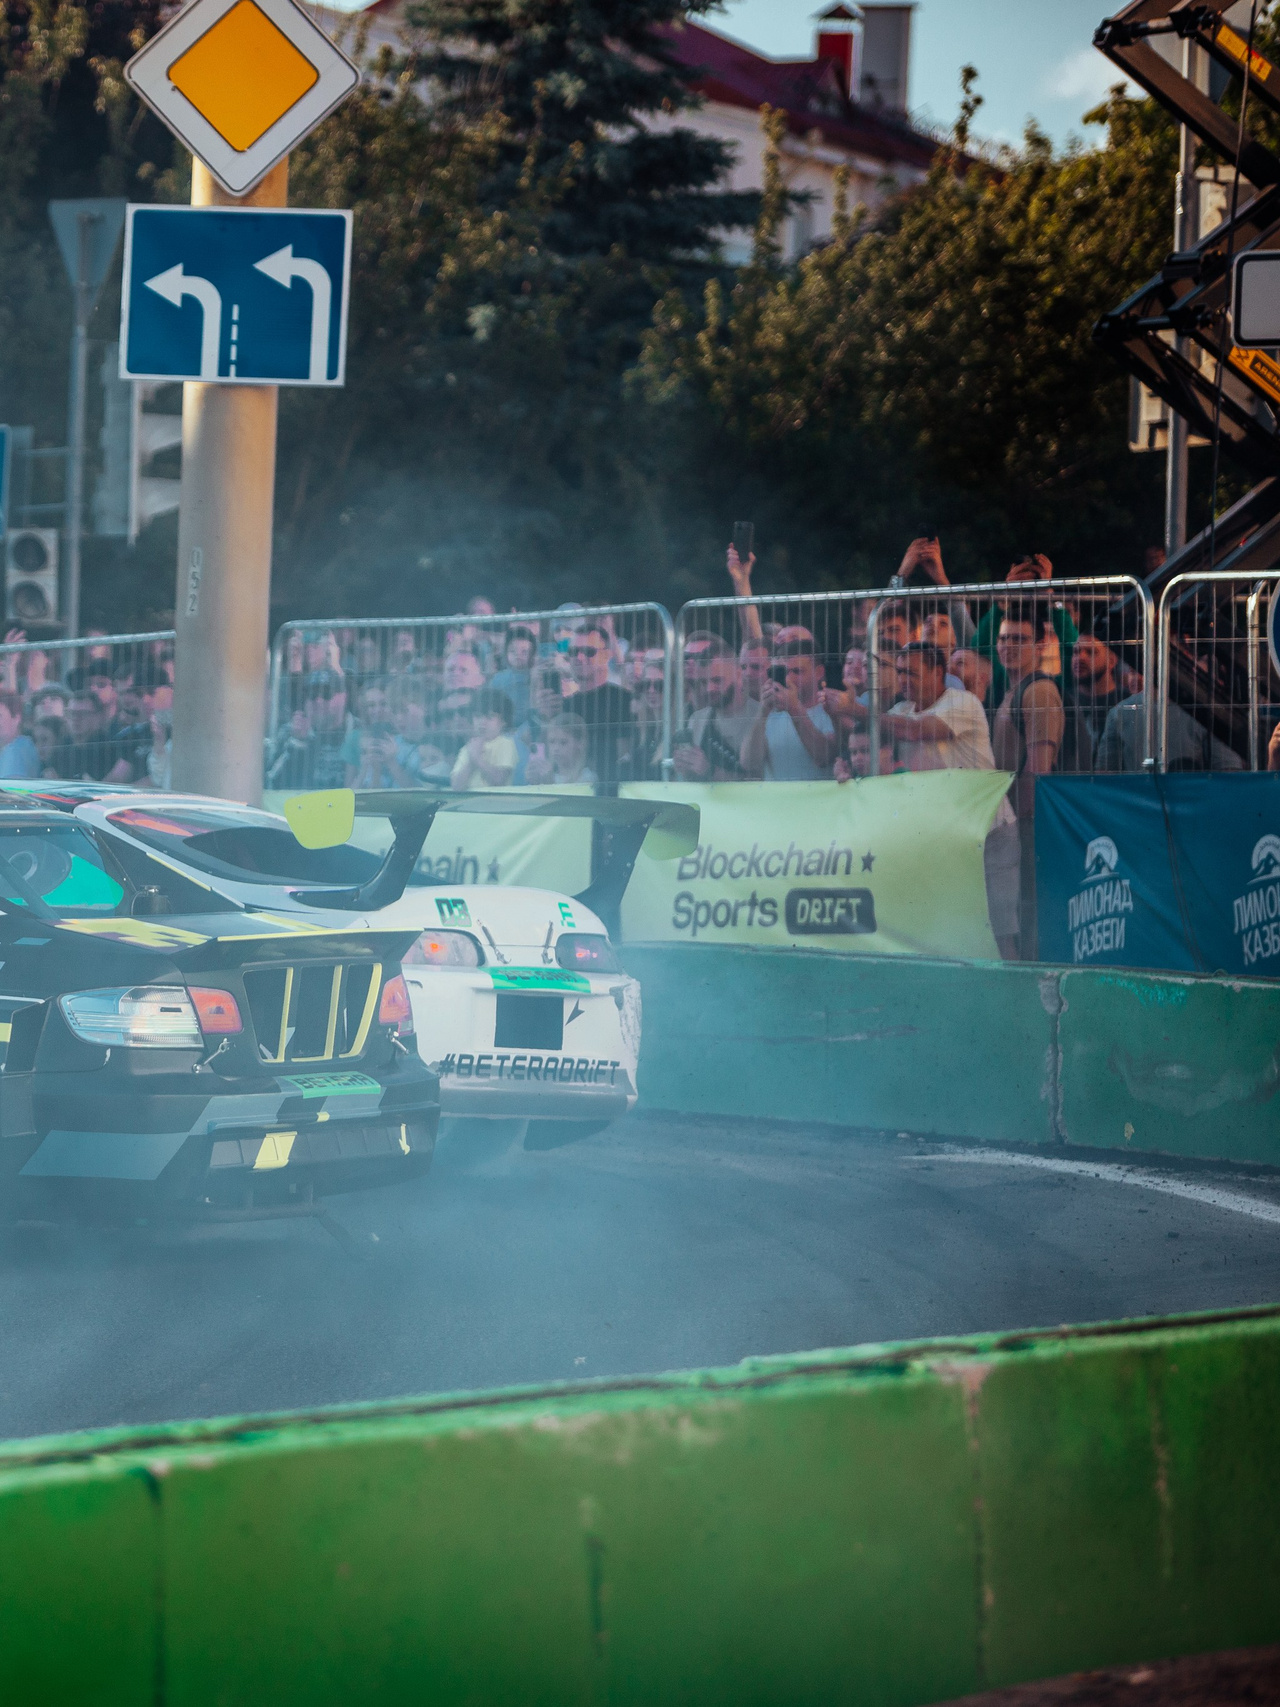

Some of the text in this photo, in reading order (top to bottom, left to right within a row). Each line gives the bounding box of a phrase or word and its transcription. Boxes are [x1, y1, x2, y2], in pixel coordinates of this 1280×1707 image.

[677, 839, 854, 881] Blockchain
[672, 890, 862, 936] Sports DRIFT
[1068, 878, 1134, 932] ЛИМОНАД
